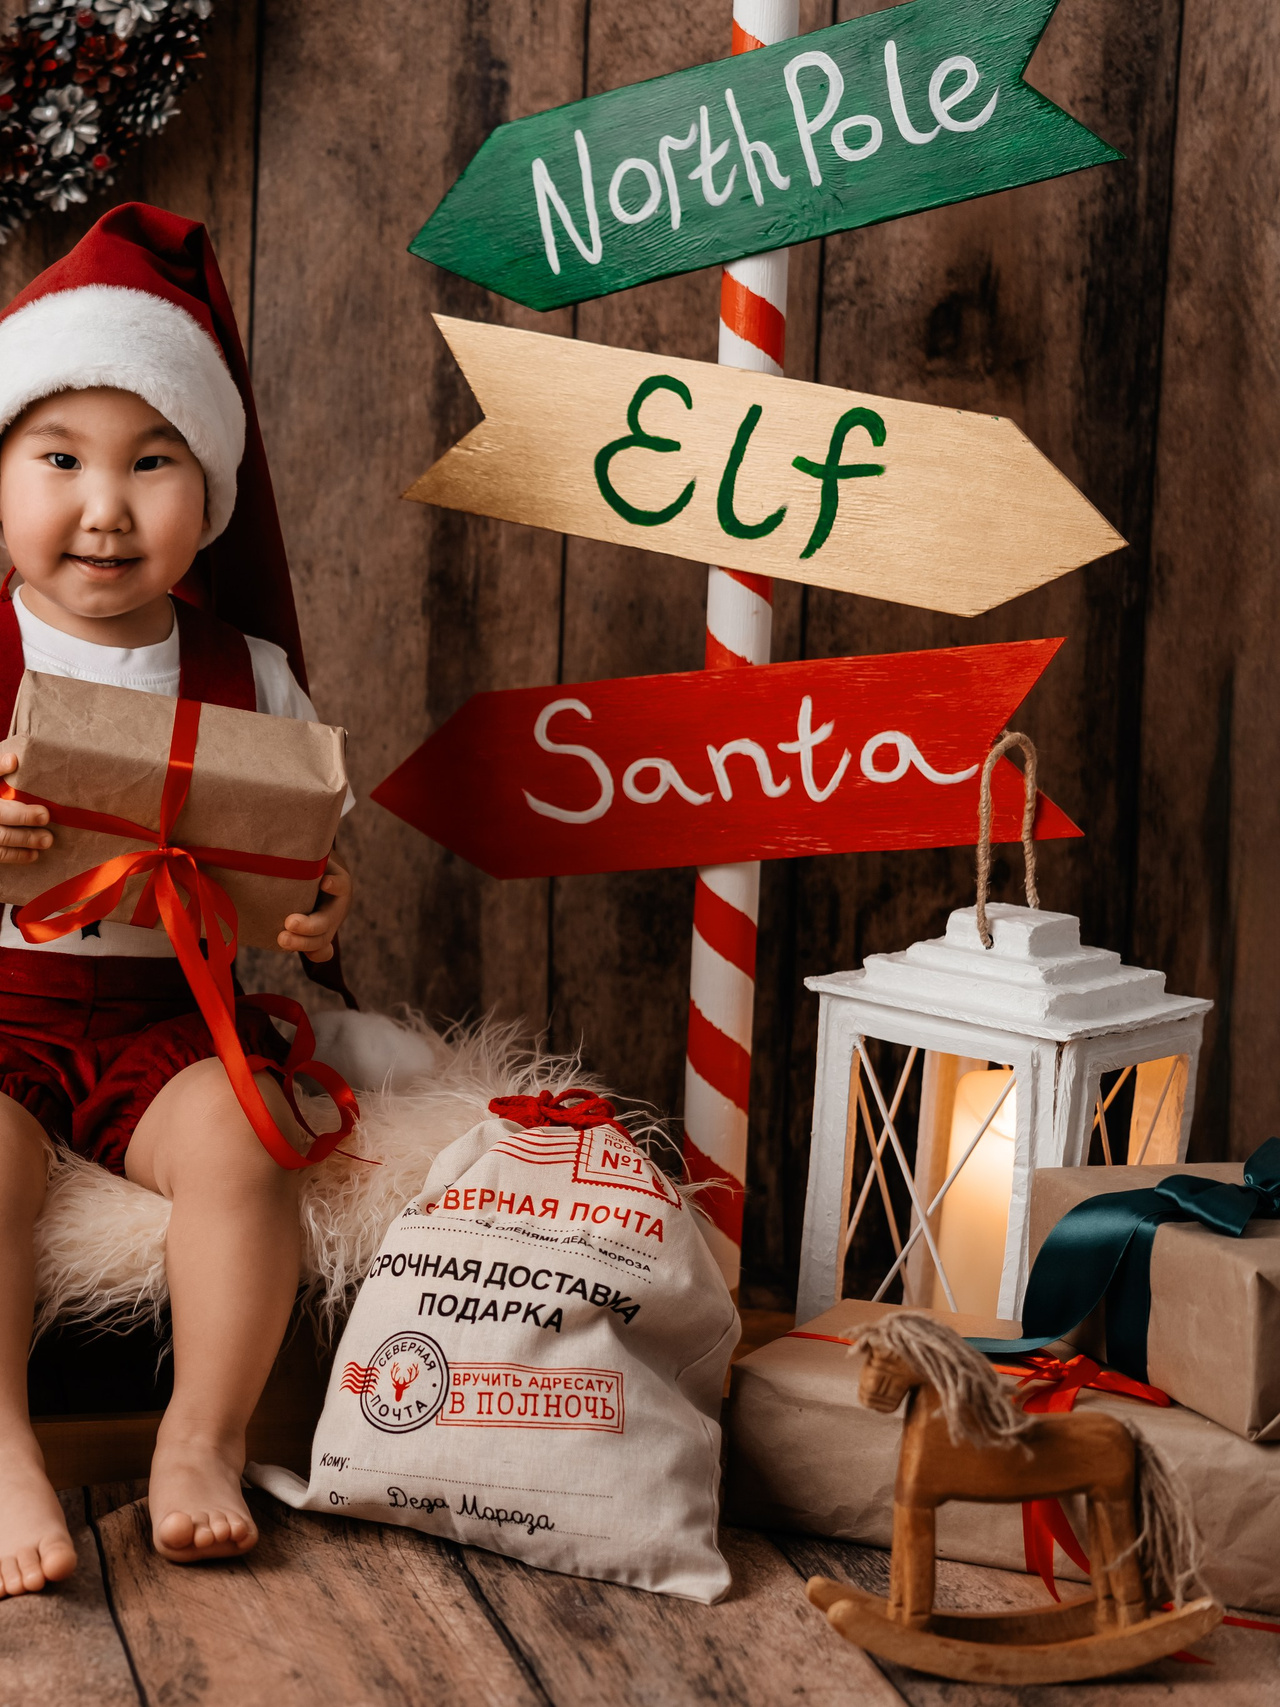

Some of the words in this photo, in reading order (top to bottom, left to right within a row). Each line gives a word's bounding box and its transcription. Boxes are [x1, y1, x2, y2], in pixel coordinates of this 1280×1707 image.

[532, 88, 790, 275] North
[782, 39, 1001, 188] Pole
[593, 374, 887, 561] Elf
[521, 695, 980, 825] Santa
[426, 1188, 559, 1220] СВЕРНАЯ
[569, 1202, 664, 1243] ПОЧТА
[599, 1247, 653, 1273] МОРОЗА
[369, 1253, 483, 1283] СРОЧНАЯ
[483, 1261, 642, 1325] ДОСТАВКА
[418, 1292, 564, 1333] ПОДАРКА
[378, 1341, 437, 1372] СЕВЕРНАЯ
[452, 1372, 523, 1388] ВРУЧИТЬ
[528, 1376, 615, 1394] АДРЕСАТУ
[369, 1394, 428, 1422] ПОЧТА
[448, 1391, 466, 1415] В
[476, 1392, 616, 1421] ПОЛНОЧЬ
[319, 1452, 351, 1472] Кому:
[328, 1490, 351, 1506] От:
[387, 1486, 450, 1514] Деда
[455, 1494, 556, 1535] Мороза
